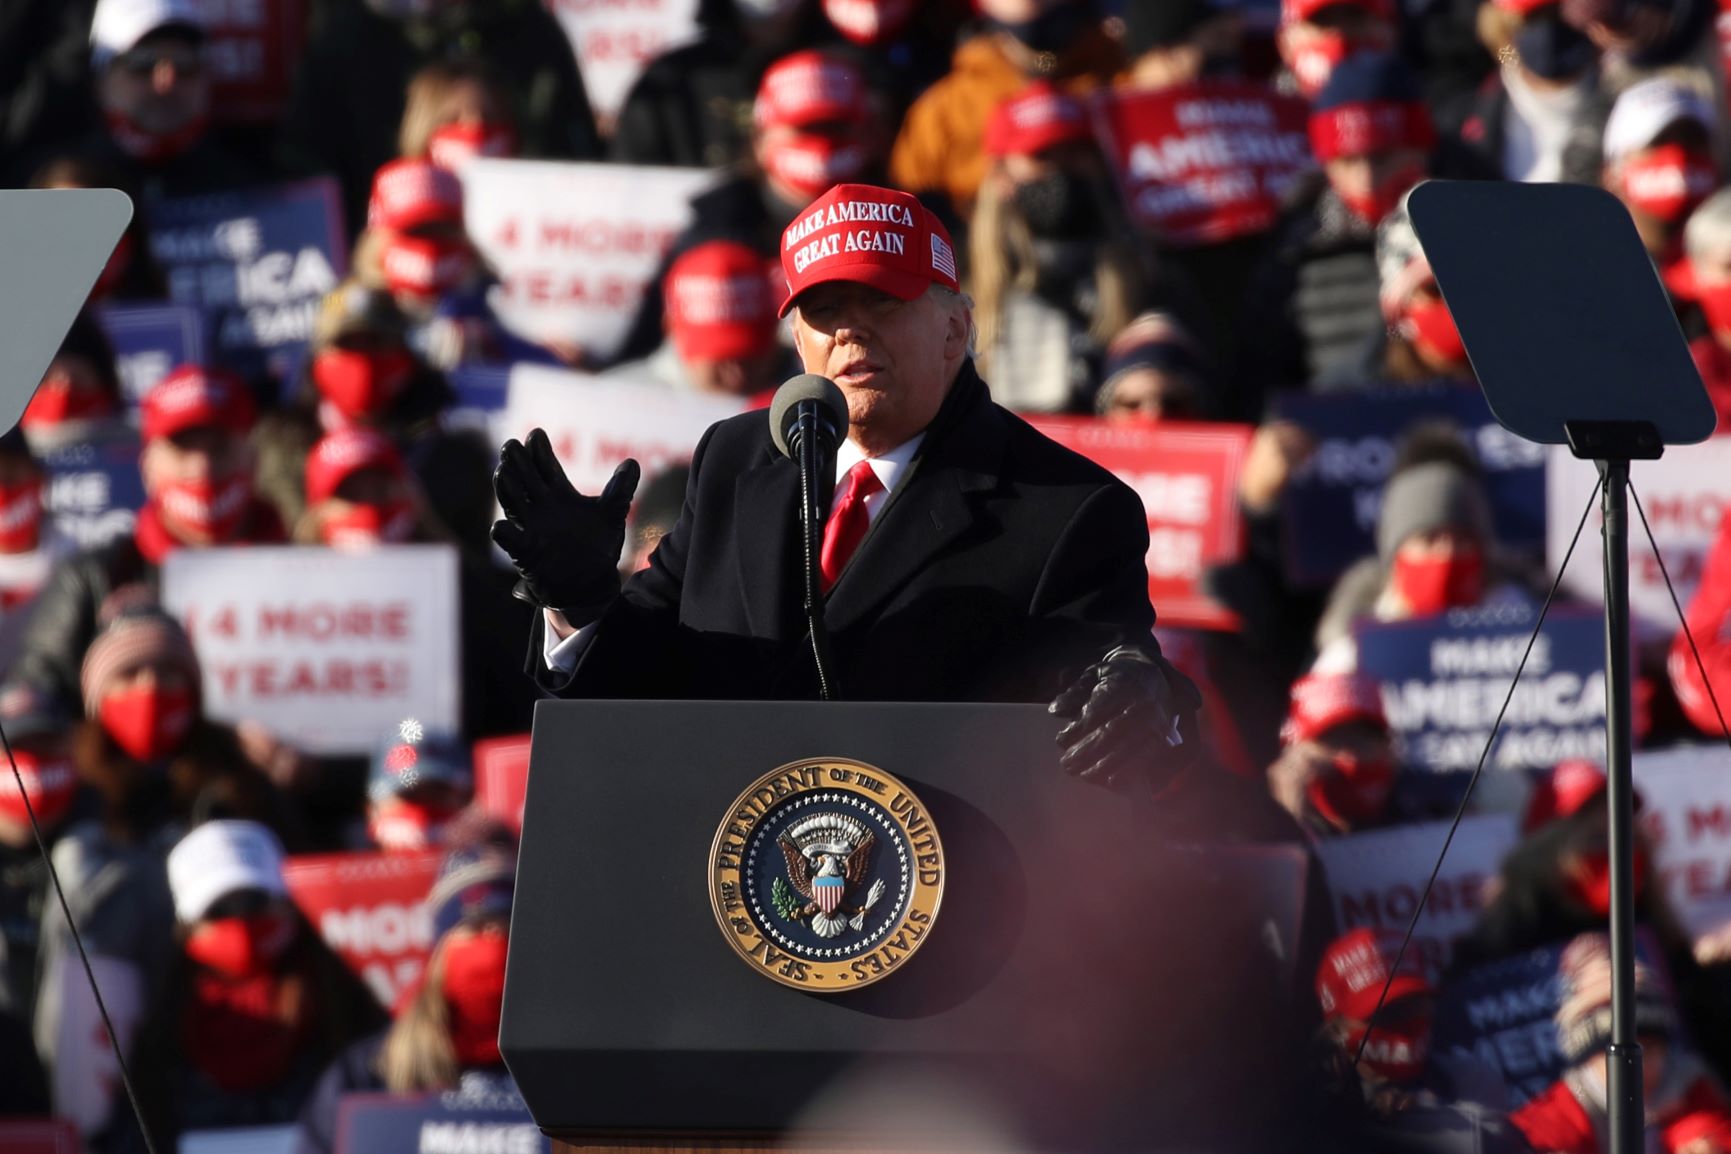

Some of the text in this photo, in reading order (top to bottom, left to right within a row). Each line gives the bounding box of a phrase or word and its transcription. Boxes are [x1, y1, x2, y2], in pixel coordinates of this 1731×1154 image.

[786, 201, 914, 250] MAKE AMERICA
[794, 230, 904, 274] GREAT AGAIN
[210, 601, 411, 642] 4 MORE
[1430, 634, 1549, 675] MAKE
[213, 659, 412, 700] YEARS!
[829, 768, 853, 782] OF
[855, 772, 888, 795] THE
[719, 766, 822, 868] PRESIDENT
[889, 792, 940, 887] UNITED
[319, 903, 434, 952] MOR
[850, 908, 930, 981] STATES
[747, 933, 810, 981] SEAL
[1467, 974, 1564, 1029] MAK
[419, 1121, 541, 1154] MAKE
